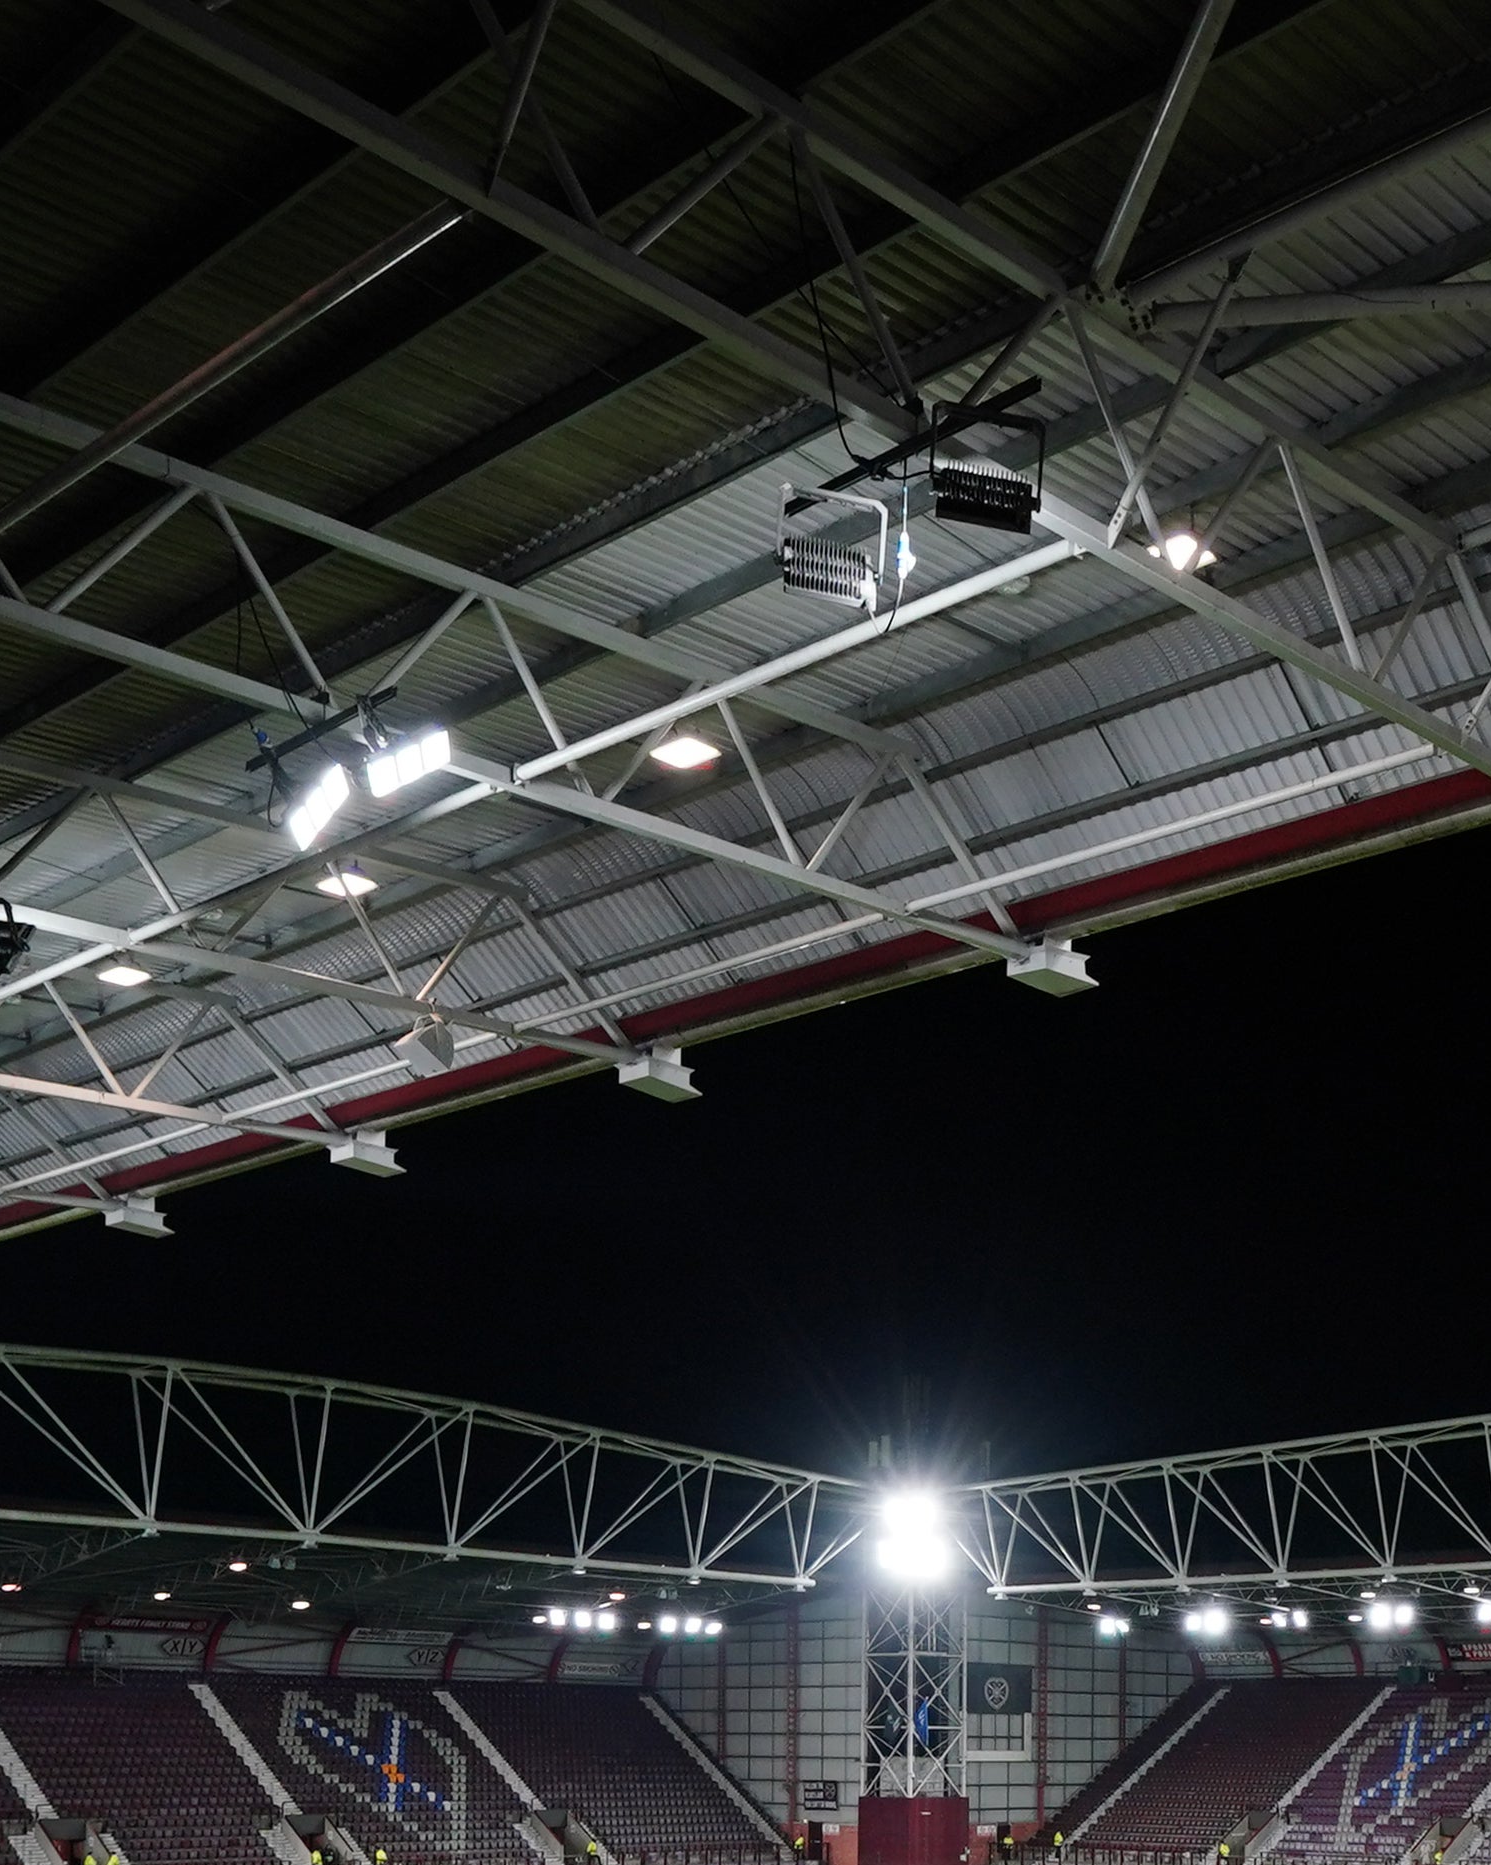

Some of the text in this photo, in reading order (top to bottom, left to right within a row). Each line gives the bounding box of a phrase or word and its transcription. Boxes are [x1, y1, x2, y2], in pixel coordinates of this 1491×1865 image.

[170, 1640, 198, 1653] X Y
[417, 1650, 439, 1663] Y Z
